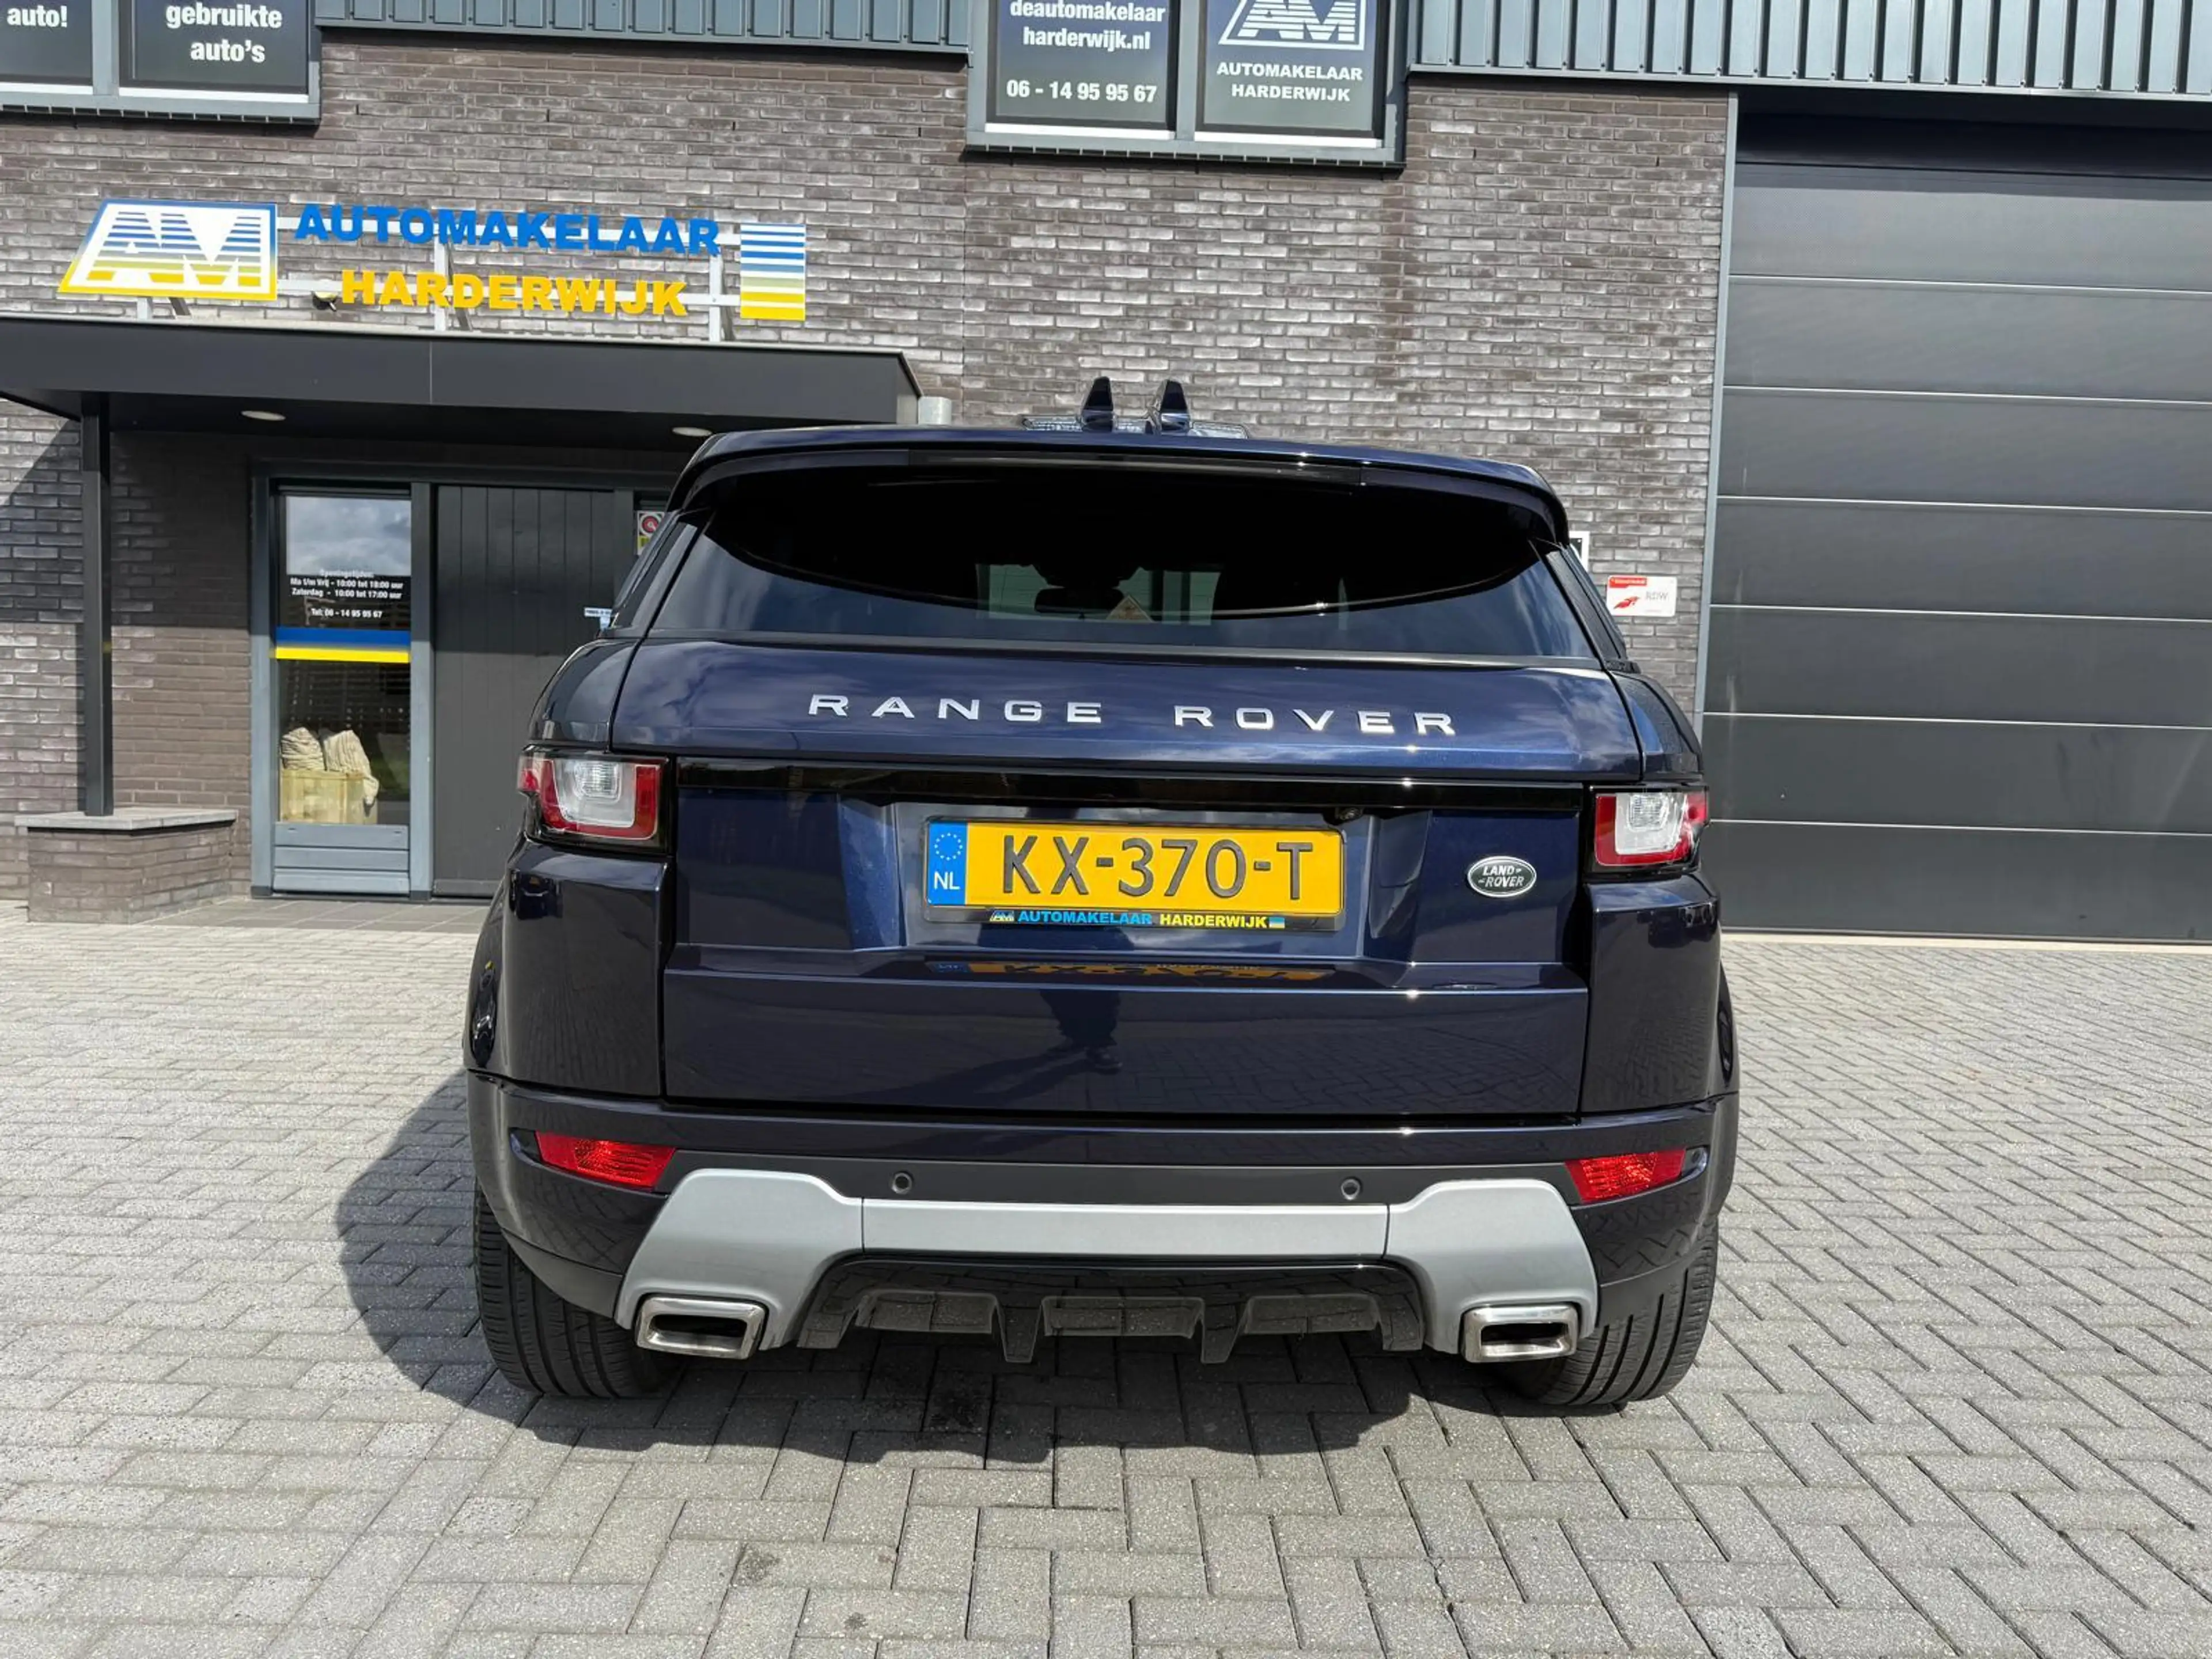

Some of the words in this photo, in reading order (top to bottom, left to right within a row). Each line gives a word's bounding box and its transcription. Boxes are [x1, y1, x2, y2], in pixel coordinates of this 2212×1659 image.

[7, 5, 67, 27] auto!
[166, 2, 282, 29] gebruikte
[1010, 0, 1166, 22] deautomakelaar
[191, 39, 265, 63] auto's
[1023, 26, 1151, 52] harderwijk.nl
[1217, 62, 1363, 80] AUTOMAKELAAR
[1007, 79, 1031, 97] 06
[1049, 81, 1073, 99] 14
[1077, 82, 1100, 100] 95
[1105, 84, 1128, 101] 95
[1133, 85, 1157, 103] 67
[1232, 84, 1350, 101] HARDERWIJK
[295, 203, 719, 255] AUTOMAKELAAR
[342, 268, 688, 316] HARDERWIJK
[808, 694, 1103, 724] RANGE
[1173, 704, 1456, 736] ROVER
[1002, 835, 1314, 900] KX-370-T
[934, 871, 960, 889] NL
[1018, 911, 1152, 925] AUTOMAKELAAR
[1159, 913, 1267, 929] HARDERWIJK
